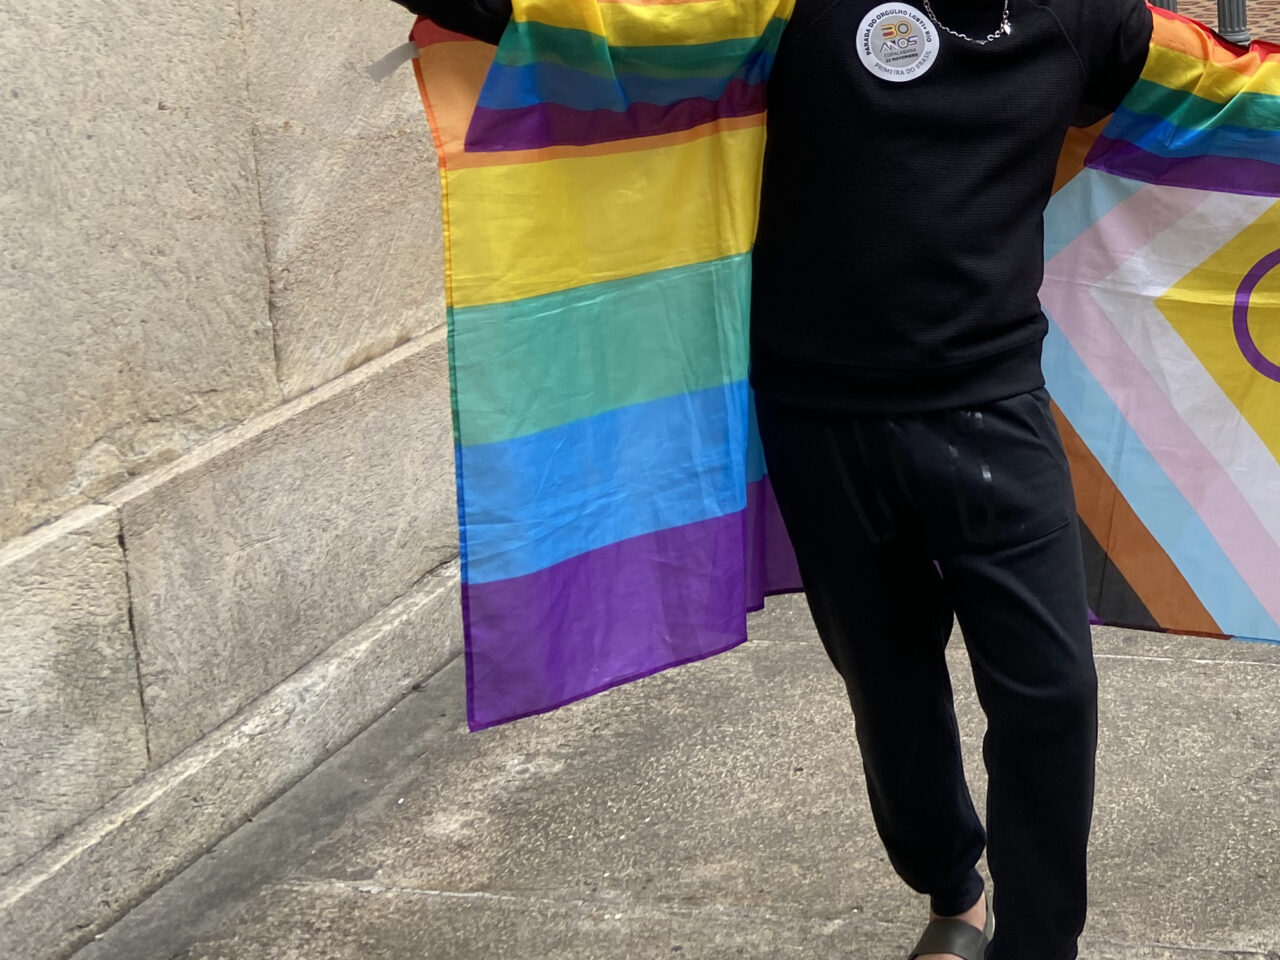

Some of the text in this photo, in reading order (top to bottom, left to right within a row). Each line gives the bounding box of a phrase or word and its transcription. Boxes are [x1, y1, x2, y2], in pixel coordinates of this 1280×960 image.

[864, 28, 872, 56] PARADA
[877, 9, 908, 20] ORGULHO
[881, 21, 912, 39] 30
[880, 36, 918, 53] ANOS
[874, 62, 905, 75] PRIMEIRA
[916, 50, 932, 70] BRASIL
